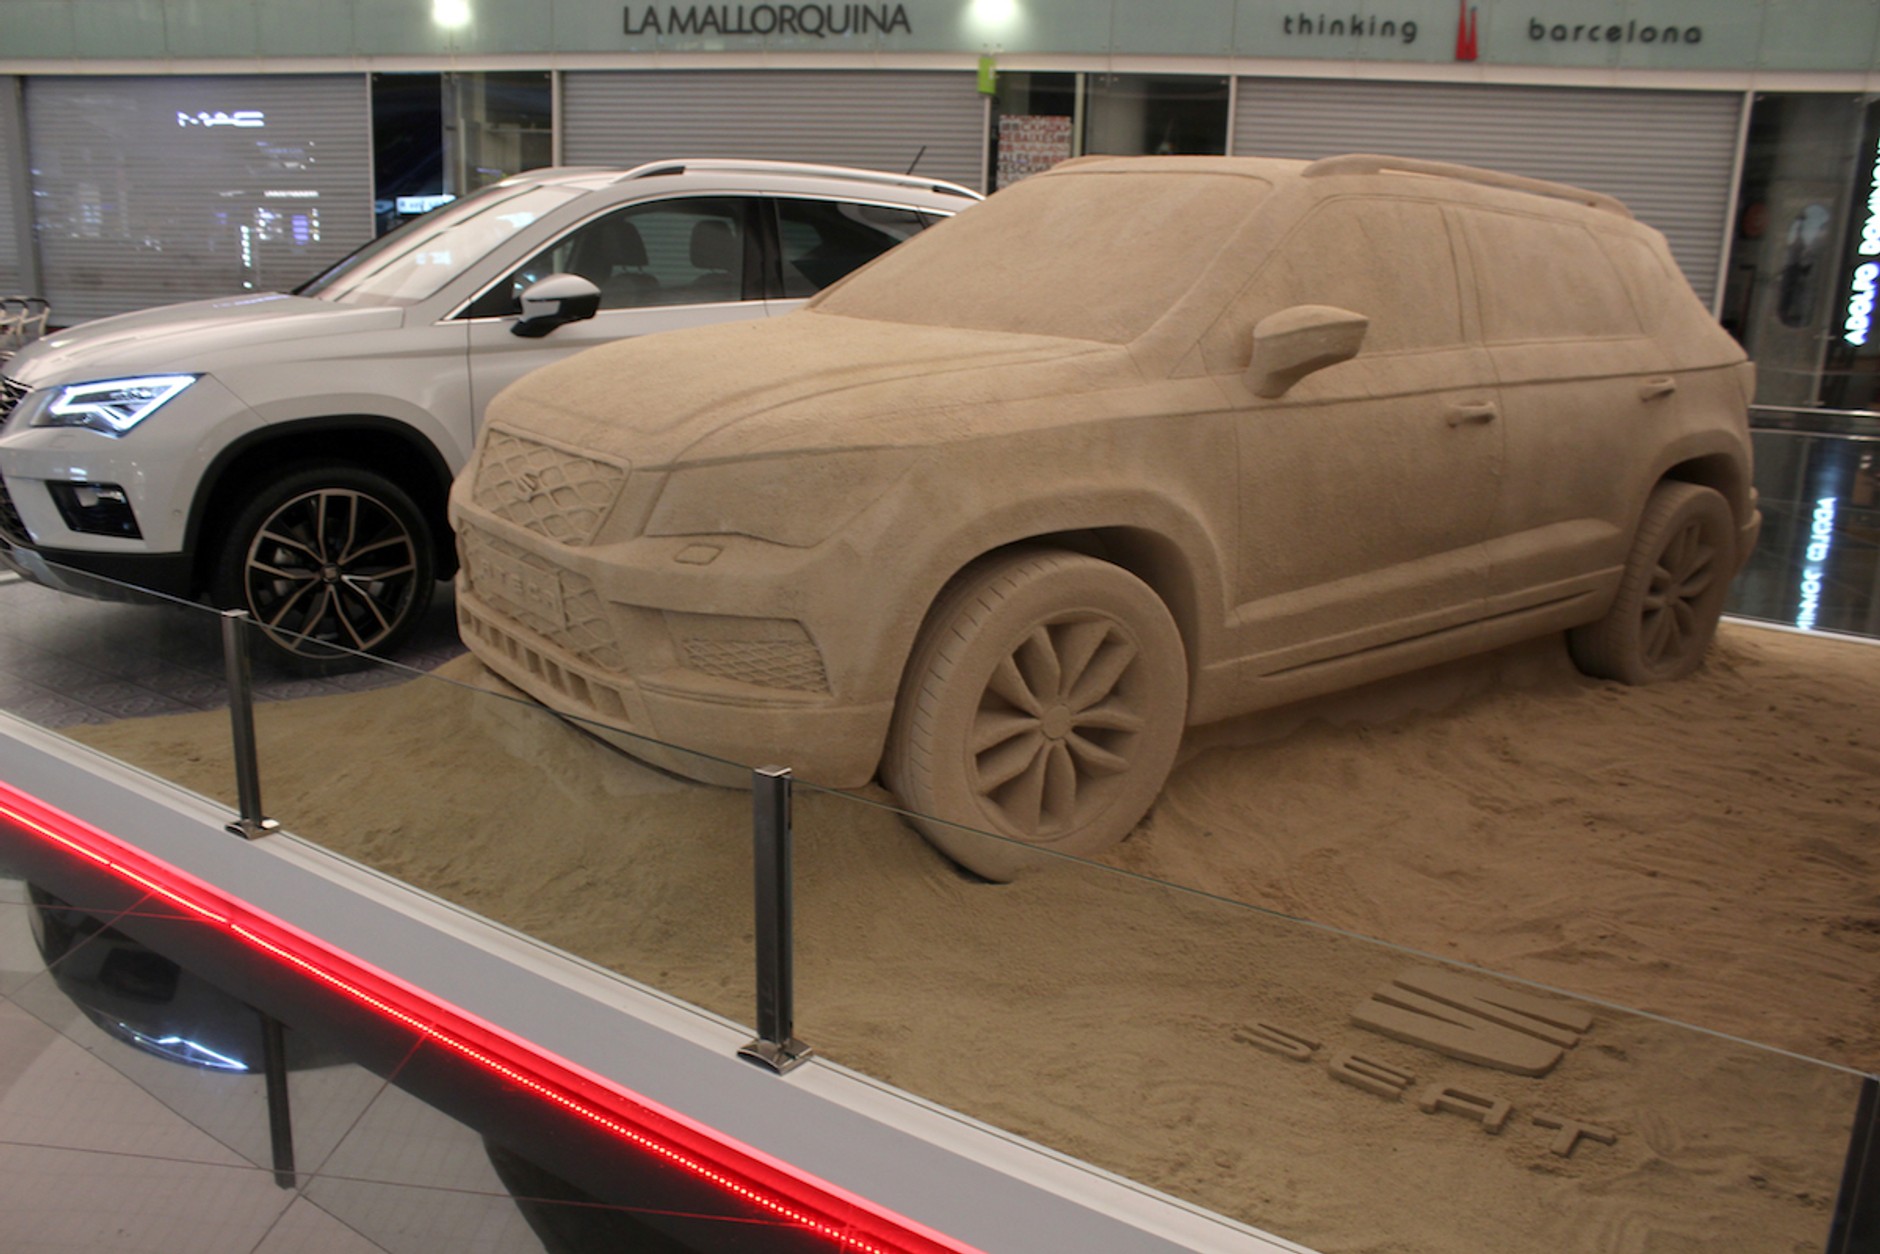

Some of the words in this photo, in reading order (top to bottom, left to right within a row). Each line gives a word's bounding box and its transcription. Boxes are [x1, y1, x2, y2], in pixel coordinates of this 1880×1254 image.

[623, 5, 663, 35] LA
[667, 4, 912, 38] MALLORQUINA
[1283, 13, 1418, 45] thinking
[1527, 17, 1703, 45] barcelona
[1843, 261, 1880, 346] ADOLFO
[1233, 1022, 1618, 1158] SEAT
